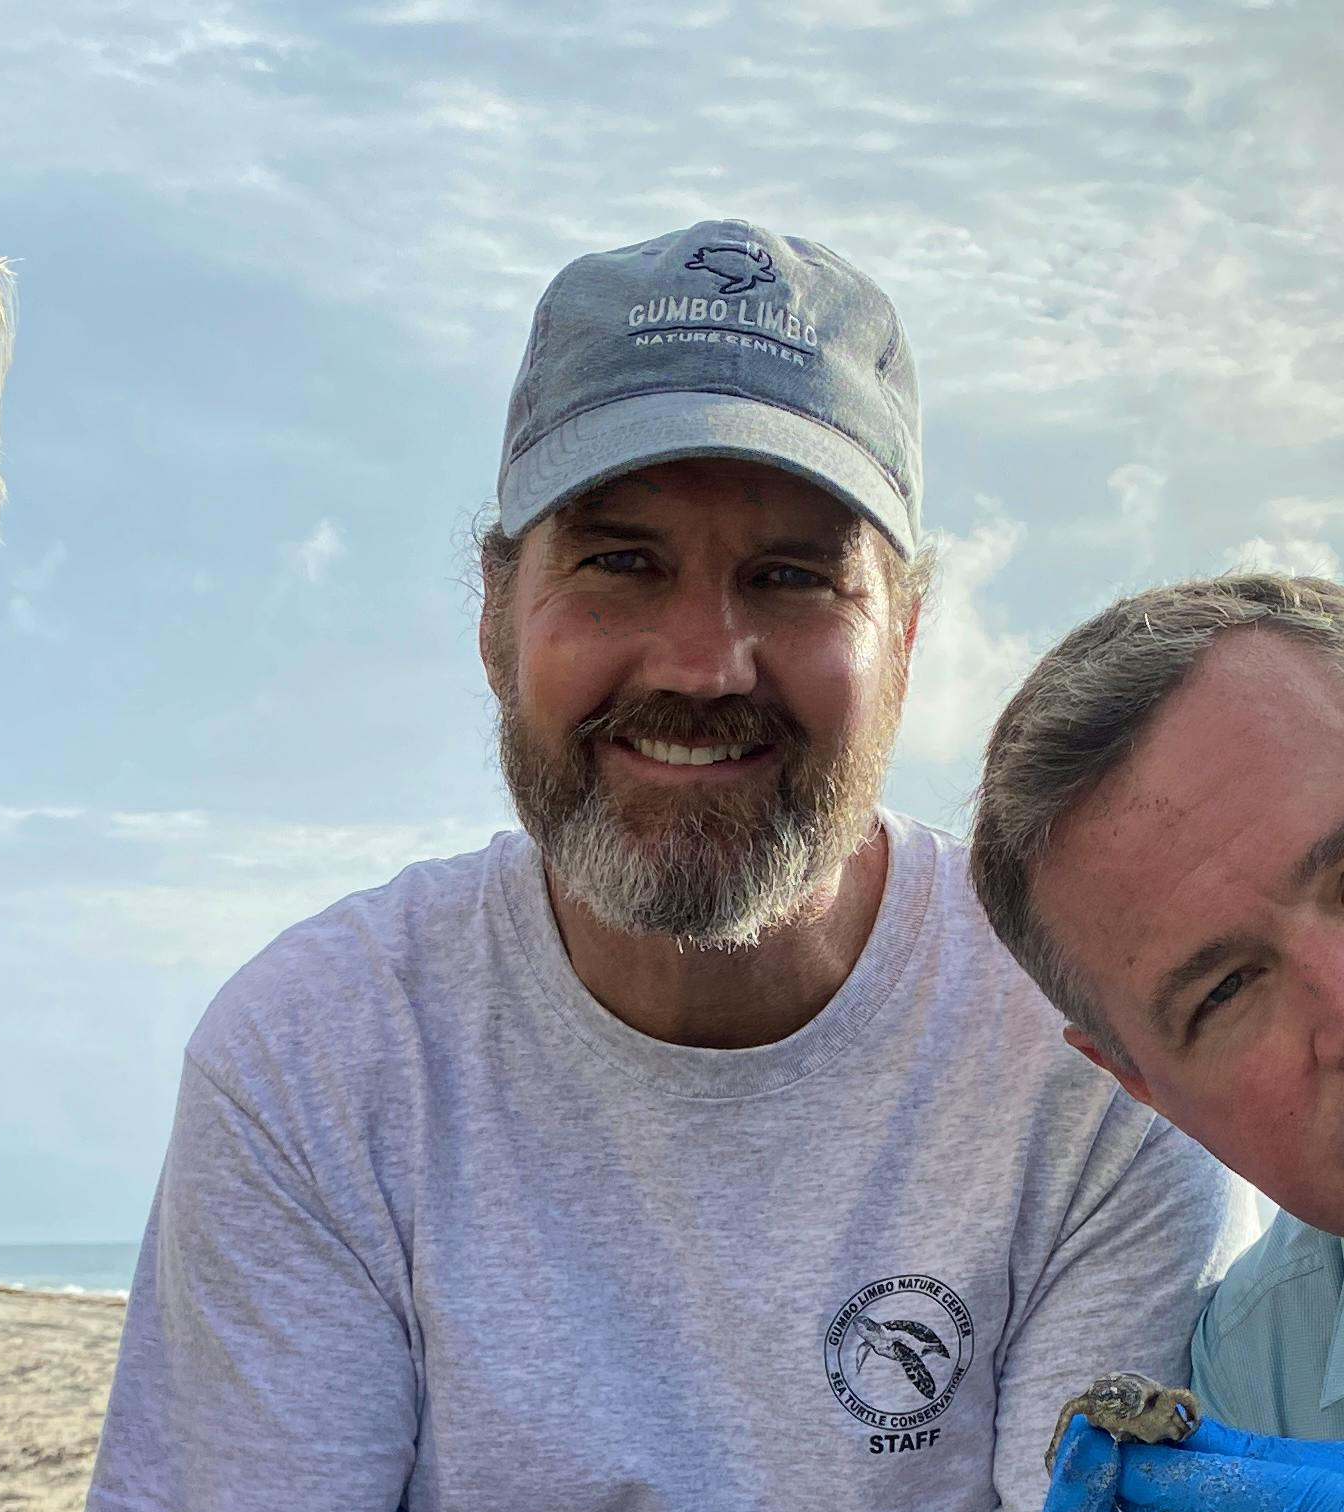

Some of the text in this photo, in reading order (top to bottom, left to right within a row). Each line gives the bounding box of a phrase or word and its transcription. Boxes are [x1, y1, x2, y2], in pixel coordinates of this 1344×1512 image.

[628, 296, 818, 347] GUMBO LIMBO
[635, 332, 804, 367] NATURE CENTER
[828, 1278, 973, 1346] GUMBO LIMBO NATURE CENTER
[830, 1367, 965, 1428] SEA TURTLE CONSERVATION
[869, 1428, 941, 1455] STAFF
